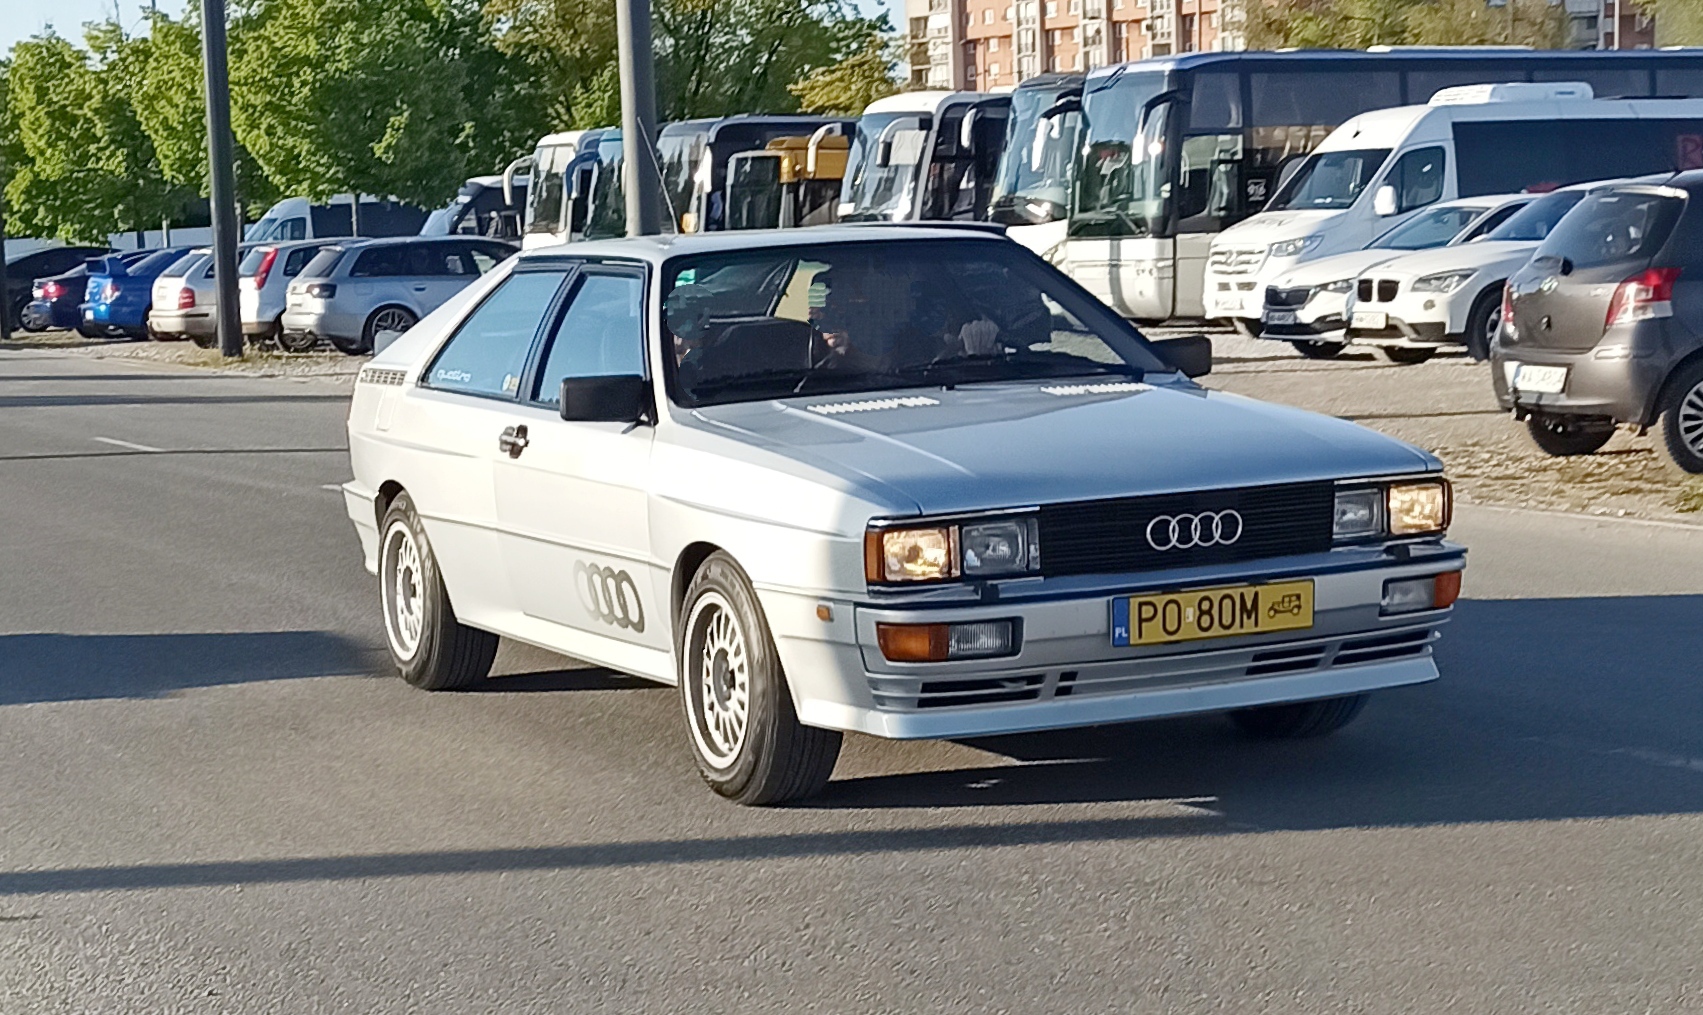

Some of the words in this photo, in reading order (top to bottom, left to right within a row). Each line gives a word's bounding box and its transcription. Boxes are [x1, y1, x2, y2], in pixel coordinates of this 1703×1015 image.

[1137, 598, 1182, 640] PO
[1196, 590, 1260, 633] 80M
[1114, 626, 1128, 639] PL
